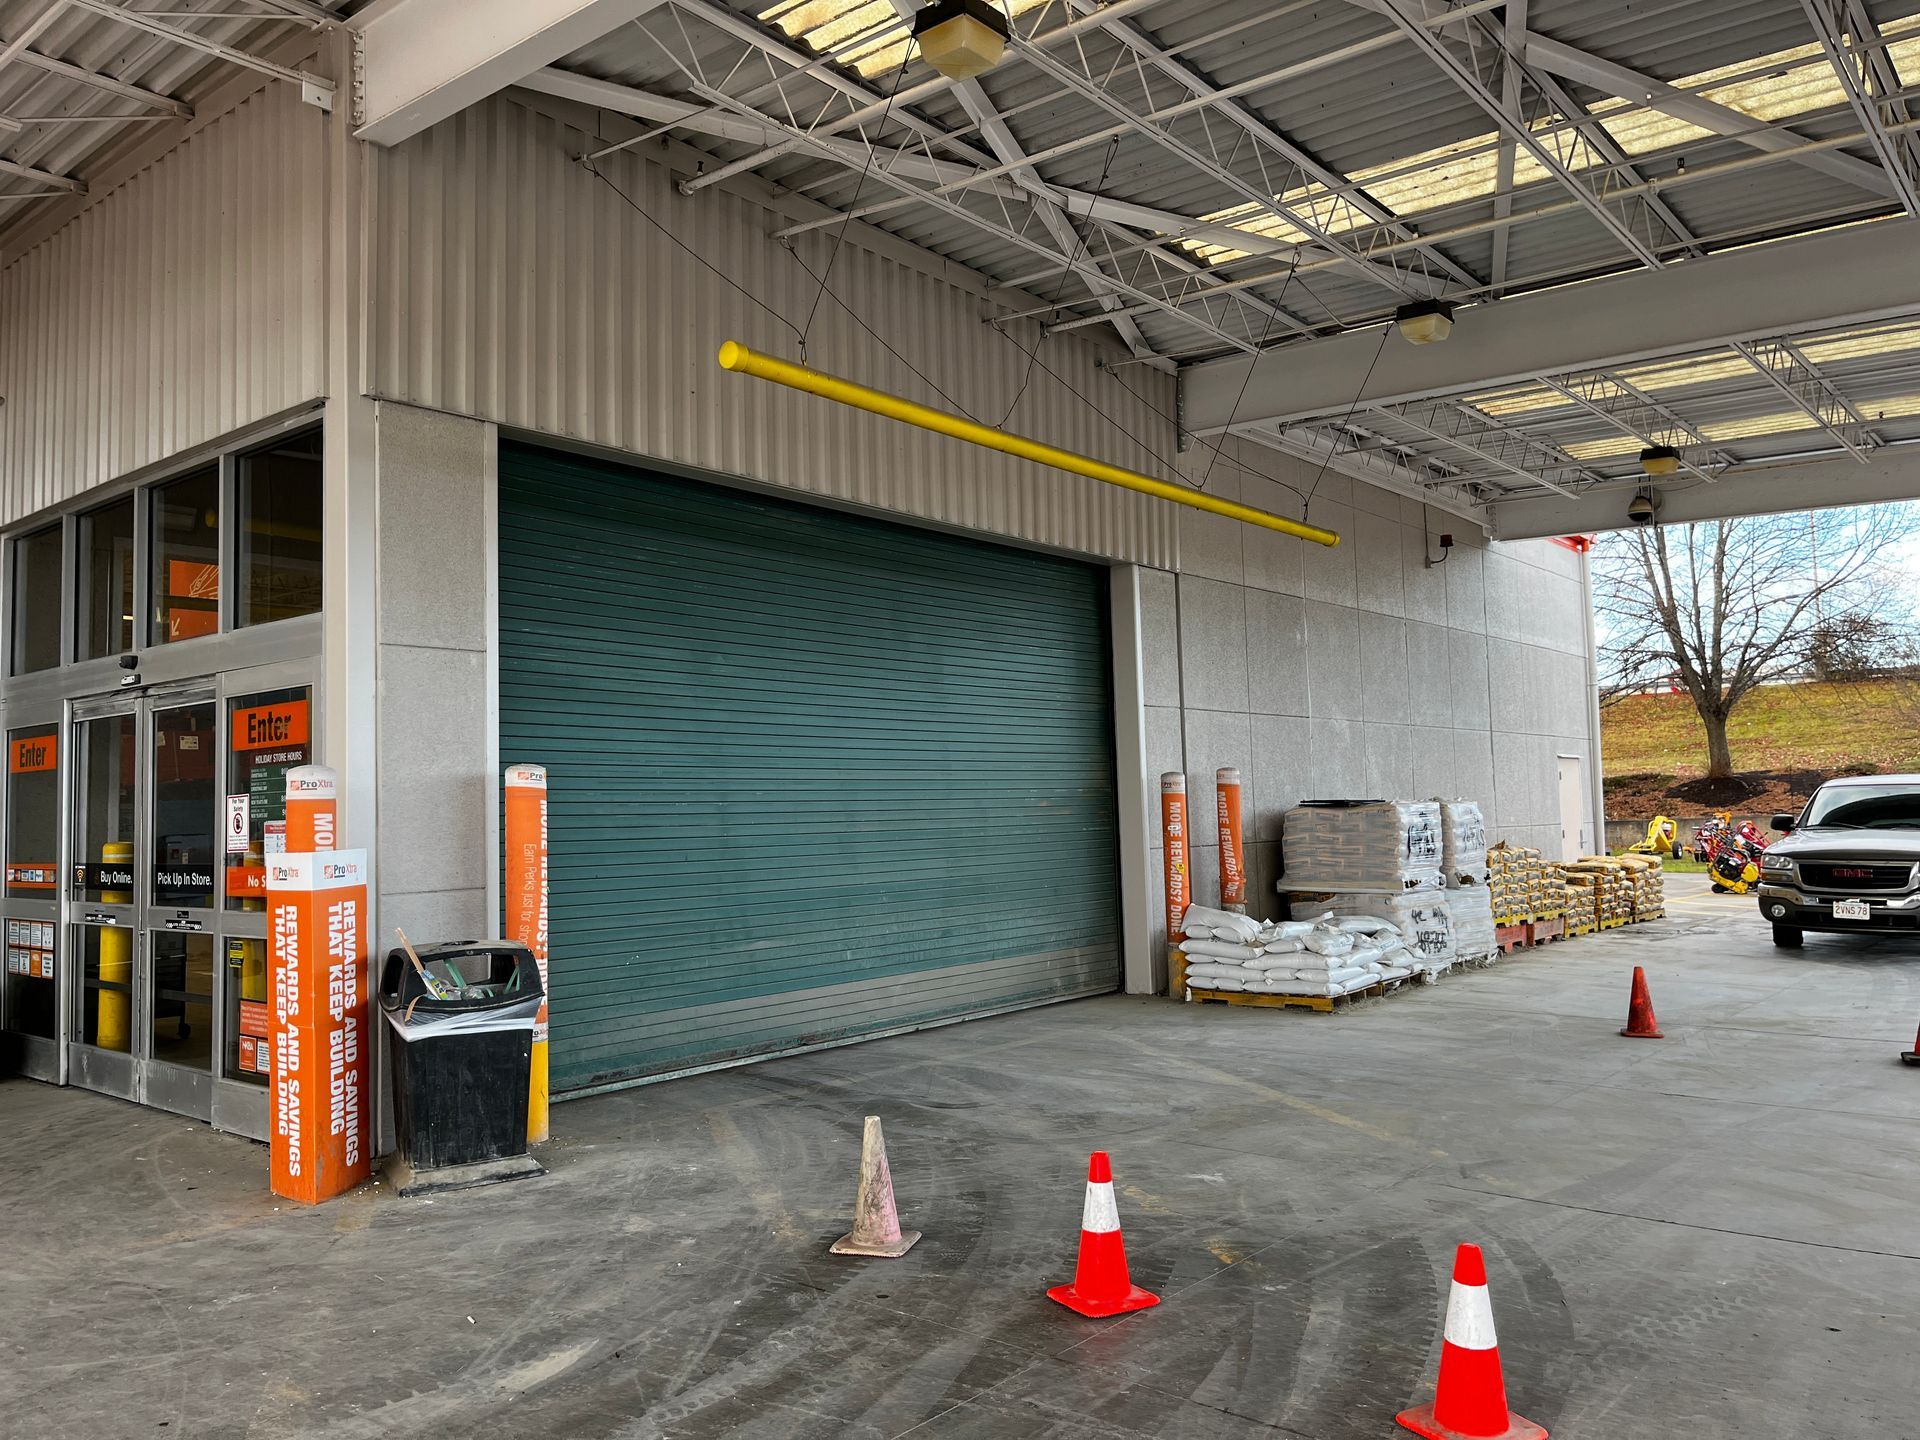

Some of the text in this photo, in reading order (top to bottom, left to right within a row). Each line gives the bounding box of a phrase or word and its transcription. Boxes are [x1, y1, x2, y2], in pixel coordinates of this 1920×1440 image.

[248, 711, 291, 744] Enter
[20, 742, 46, 768] Enter
[255, 751, 303, 764] HOLIDAY STORE HOURS
[300, 780, 333, 788] Pro Xtra
[313, 813, 334, 853] MO
[523, 843, 537, 864] Earn
[278, 867, 299, 878] Pro Xtra
[333, 863, 357, 876] Pro Xtra
[1833, 868, 1874, 878] GMC
[100, 870, 133, 885] Buy Online.
[157, 872, 212, 887] Pick Up In Store.
[248, 875, 260, 888] No
[523, 866, 537, 891] Perks
[521, 893, 536, 908] just
[520, 910, 534, 923] for
[1857, 907, 1868, 916] 78
[275, 904, 288, 1136] THAT KEEP BUILDING
[328, 901, 344, 1136] THAT KEEP BUILDING
[286, 905, 301, 1177] REWARDS AND SAVINGS
[343, 901, 358, 1167] REWARDS AND SAVINGS
